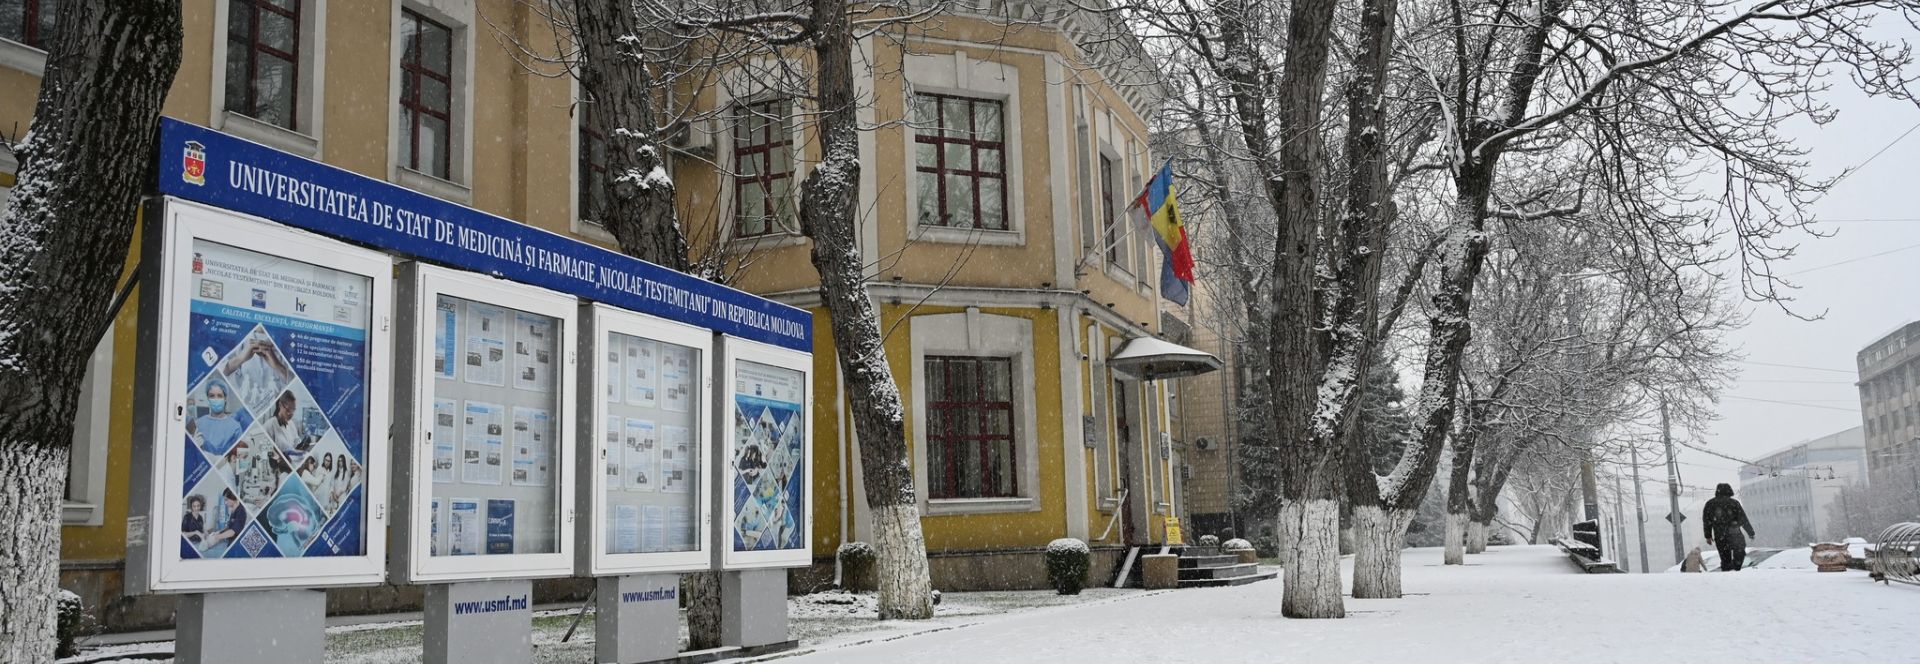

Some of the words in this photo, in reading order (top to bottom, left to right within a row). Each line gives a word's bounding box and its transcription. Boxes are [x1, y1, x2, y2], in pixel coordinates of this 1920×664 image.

[229, 160, 369, 223] UNIVERSITATEA
[372, 201, 393, 230] DE
[396, 208, 431, 239] STAT
[435, 219, 454, 245] DE
[458, 225, 523, 264] MEDICINĂ
[525, 245, 536, 271] ȘI
[538, 249, 595, 283] FARMACIE
[712, 299, 727, 319] DIN
[728, 303, 770, 332] REPUBLICA
[770, 316, 805, 341] MOLDOVA
[205, 259, 250, 274] UNIVERSITATEA
[623, 586, 676, 603] www.usmf.md
[455, 594, 527, 615] www.usmf.md
